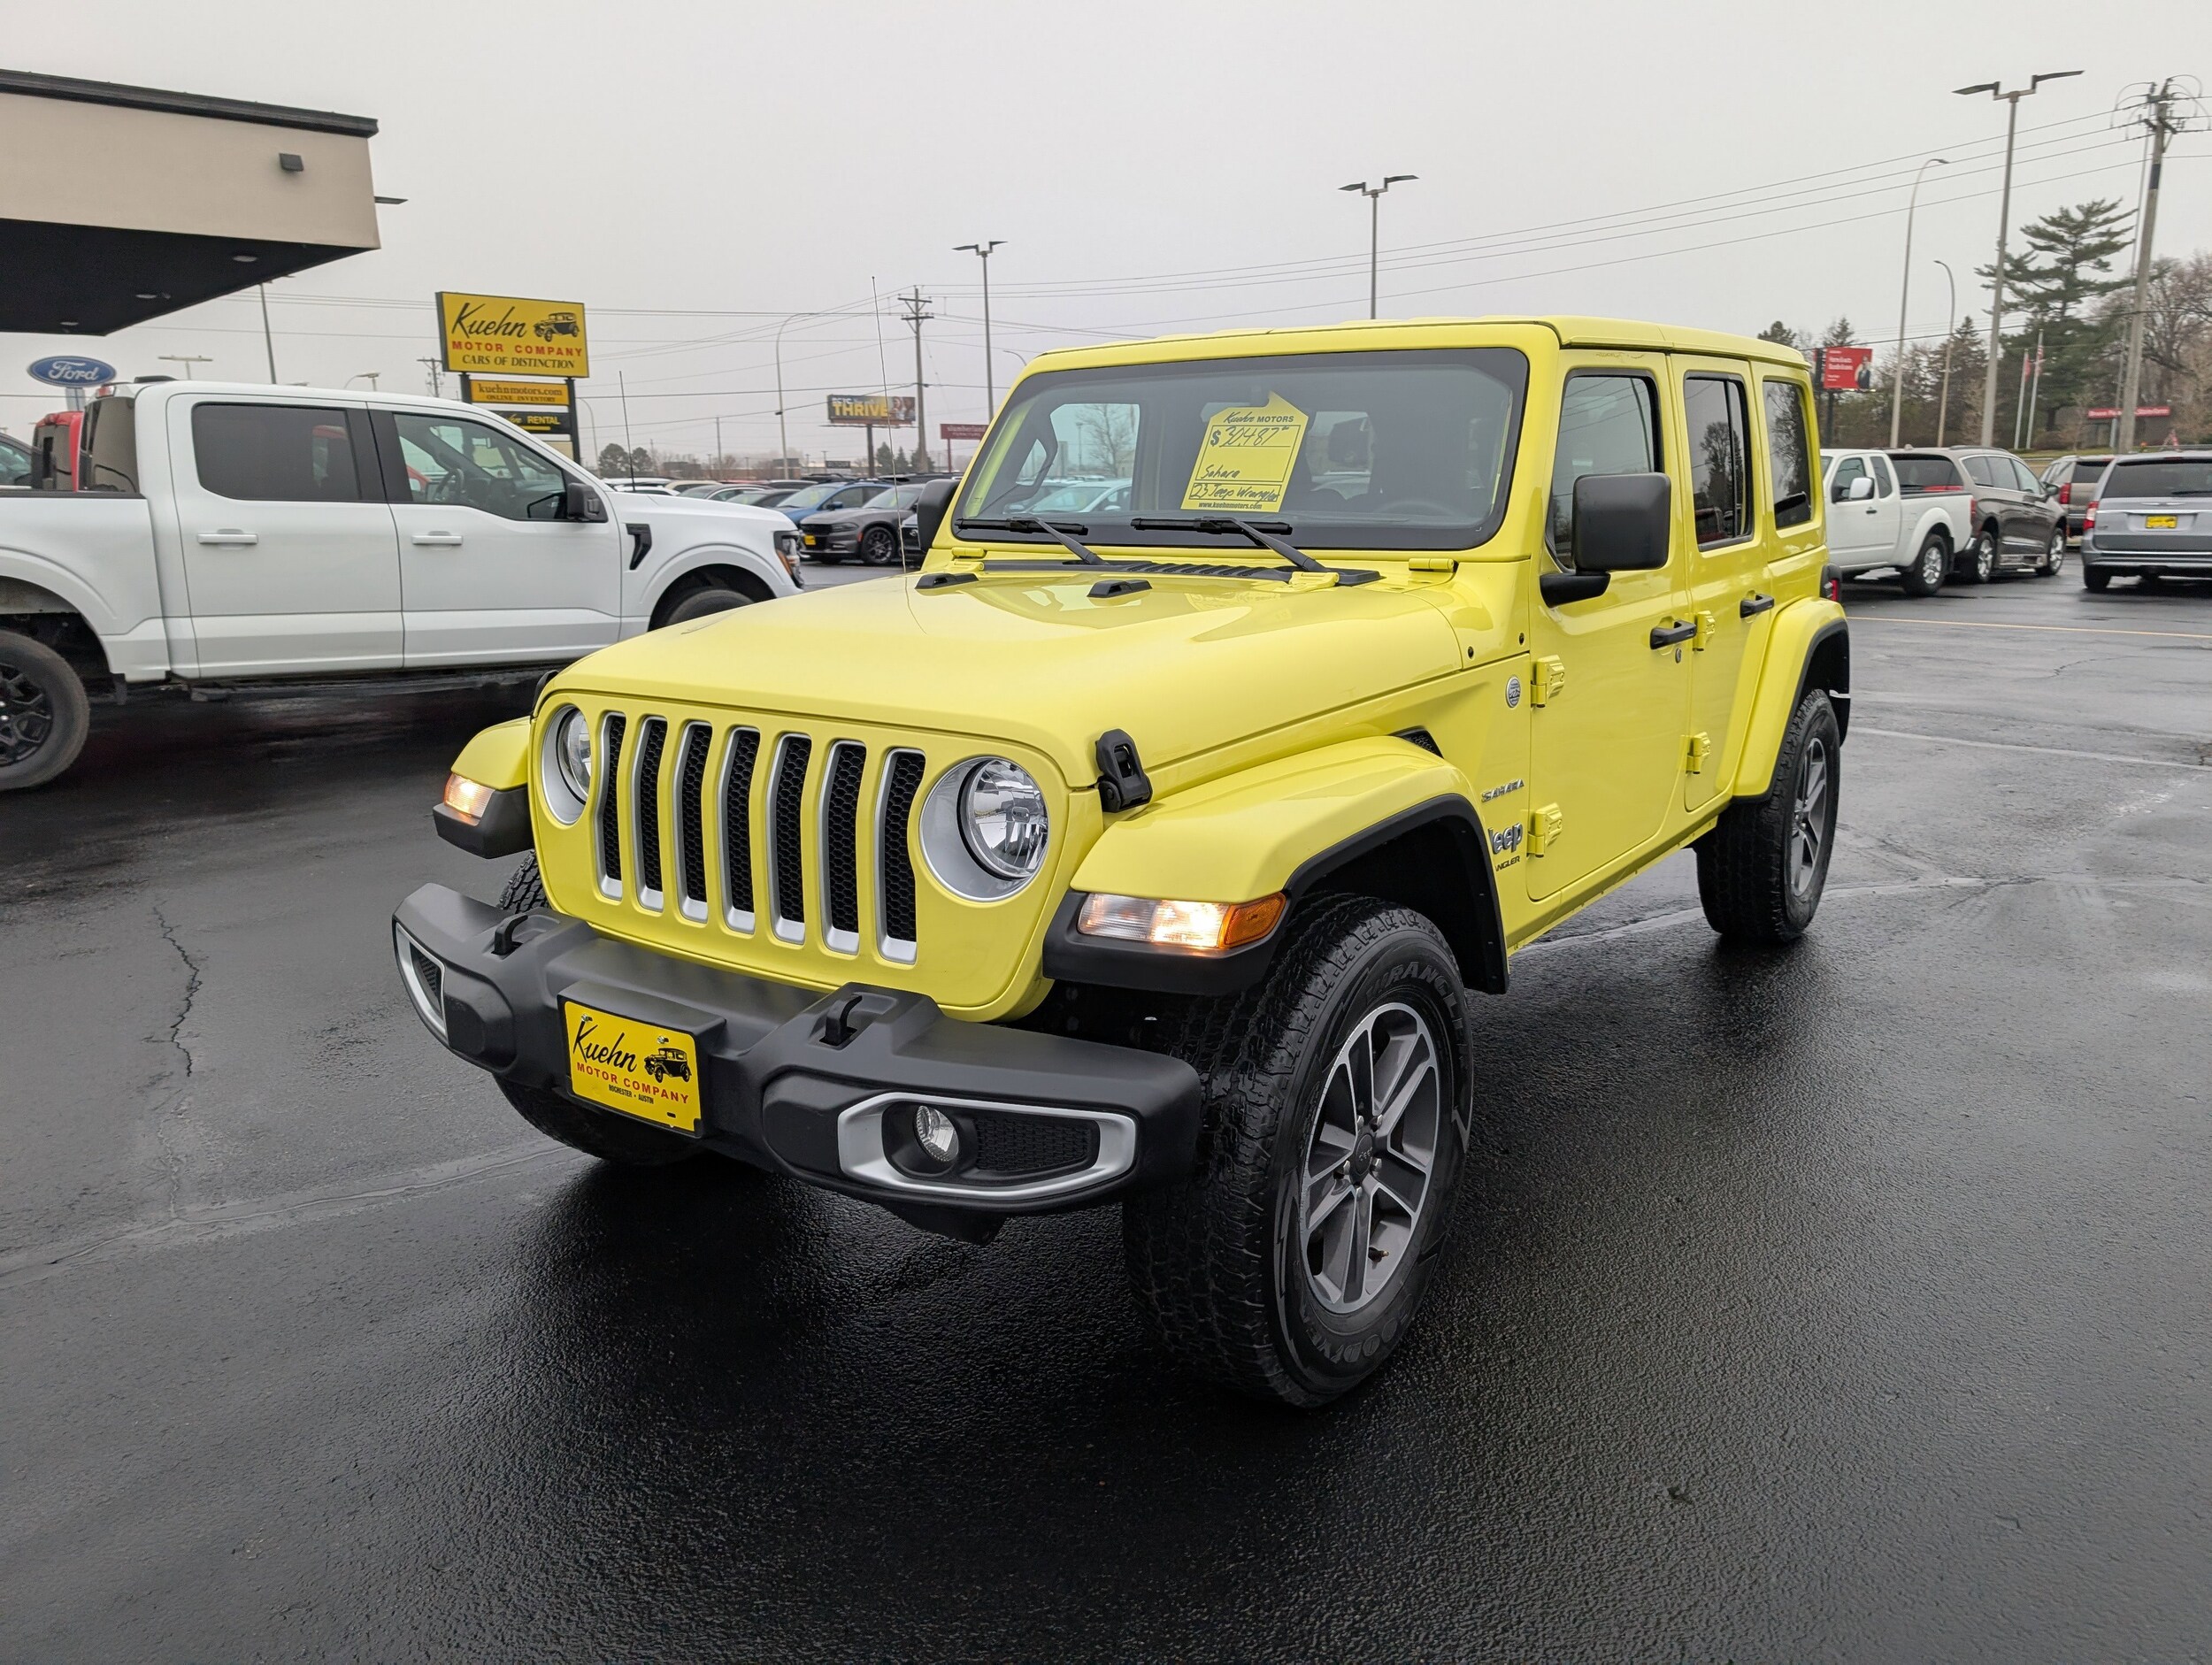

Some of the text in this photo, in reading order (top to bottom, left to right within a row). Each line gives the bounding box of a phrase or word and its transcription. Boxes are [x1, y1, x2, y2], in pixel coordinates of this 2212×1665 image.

[451, 303, 527, 339] Kuehn
[452, 341, 582, 357] MOTOR COMPANY
[49, 360, 100, 380] Ford
[462, 355, 575, 368] CARS OF DISTINCTION
[478, 383, 563, 395] kuehnmotors.com
[526, 415, 561, 425] RENTAL
[1210, 429, 1222, 447] $
[1209, 483, 1234, 500] Jeep
[1481, 779, 1525, 803] SAHARA
[572, 1020, 638, 1072] Kuehn
[576, 1062, 689, 1104] MOTOR COMPANY
[609, 1084, 655, 1104] ROCHESTER AUSTIN
